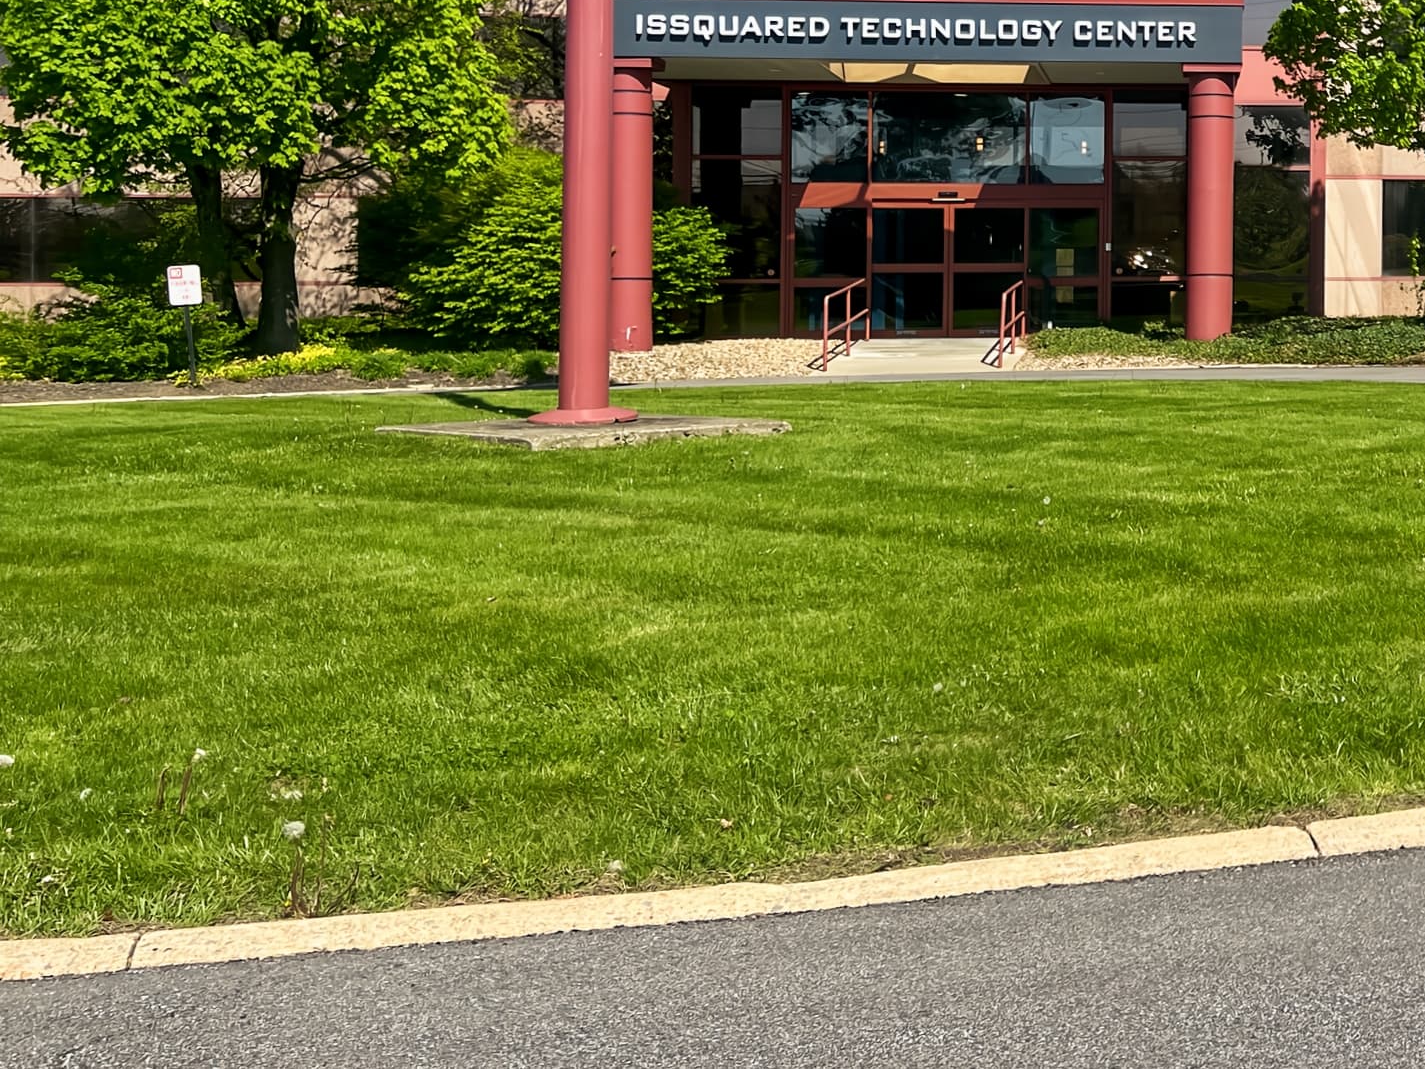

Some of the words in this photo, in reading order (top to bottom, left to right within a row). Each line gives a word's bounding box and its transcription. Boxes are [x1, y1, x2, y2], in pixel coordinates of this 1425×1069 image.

[635, 14, 831, 40] ISSQUARED
[840, 17, 1063, 40] TECHNOLOGY
[1073, 20, 1197, 41] CENTER
